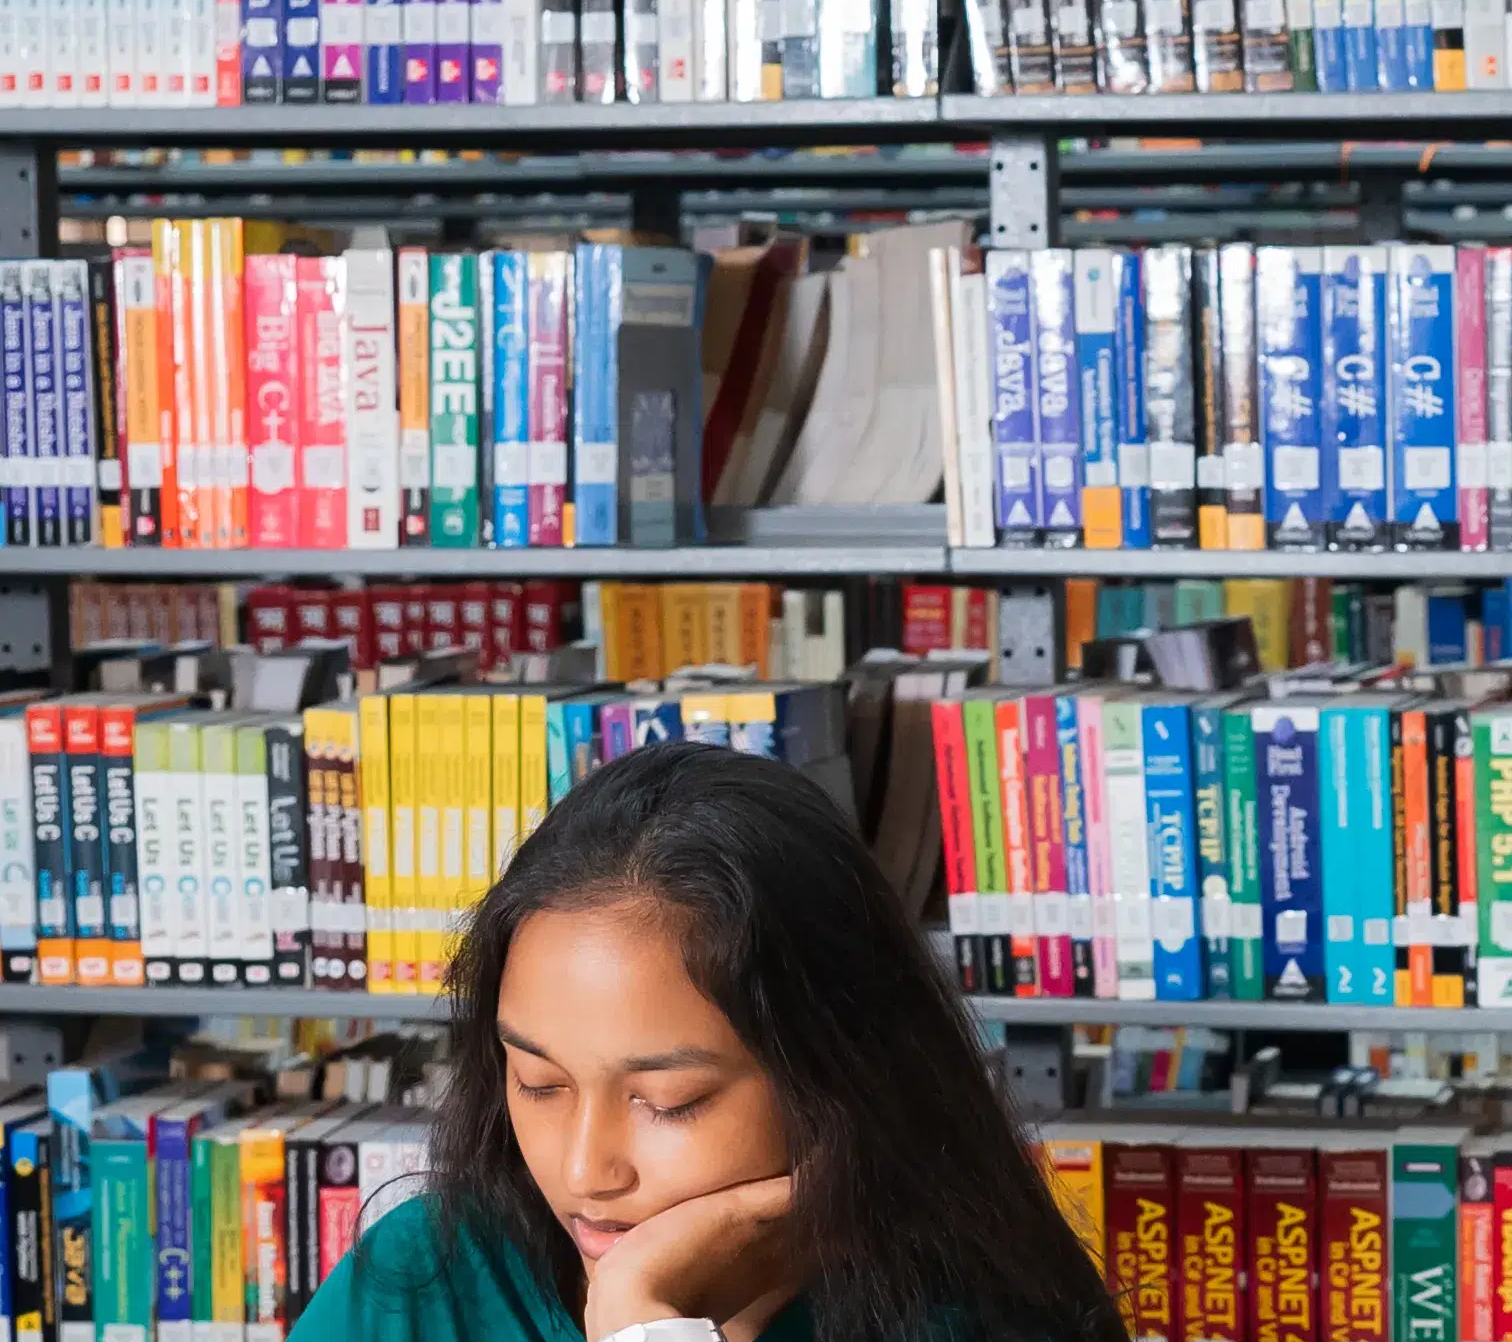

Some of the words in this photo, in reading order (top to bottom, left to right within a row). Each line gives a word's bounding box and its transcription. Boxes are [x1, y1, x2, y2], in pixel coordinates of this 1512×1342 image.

[253, 315, 285, 372] Big
[352, 321, 387, 411] Java
[434, 306, 472, 413] J2EE
[999, 340, 1028, 415] Java
[1040, 340, 1066, 416] Java
[1339, 355, 1375, 417] C#
[1405, 355, 1442, 417] C#
[177, 798, 195, 832] Let
[211, 799, 228, 833] Let
[243, 800, 259, 833] Let
[1198, 786, 1220, 863] TCP/IP
[1271, 785, 1290, 899] Development
[1288, 807, 1306, 880] Android
[179, 838, 195, 867] Us
[212, 839, 228, 868] Us
[244, 839, 259, 868] Us
[1161, 811, 1184, 889] TCP/IP
[180, 875, 198, 895] C
[213, 876, 232, 897] C
[246, 878, 264, 897] C
[64, 1227, 85, 1305] Java
[160, 1248, 186, 1301] C++
[1137, 1201, 1168, 1324] ASP.NET
[1187, 1261, 1203, 1282] C#
[1205, 1203, 1232, 1330] ASP.NET
[1258, 1262, 1273, 1284] C#
[1278, 1204, 1307, 1331] ASP.NET
[1350, 1208, 1380, 1334] ASP.NET
[1187, 1287, 1202, 1322] and
[1259, 1289, 1275, 1323] and
